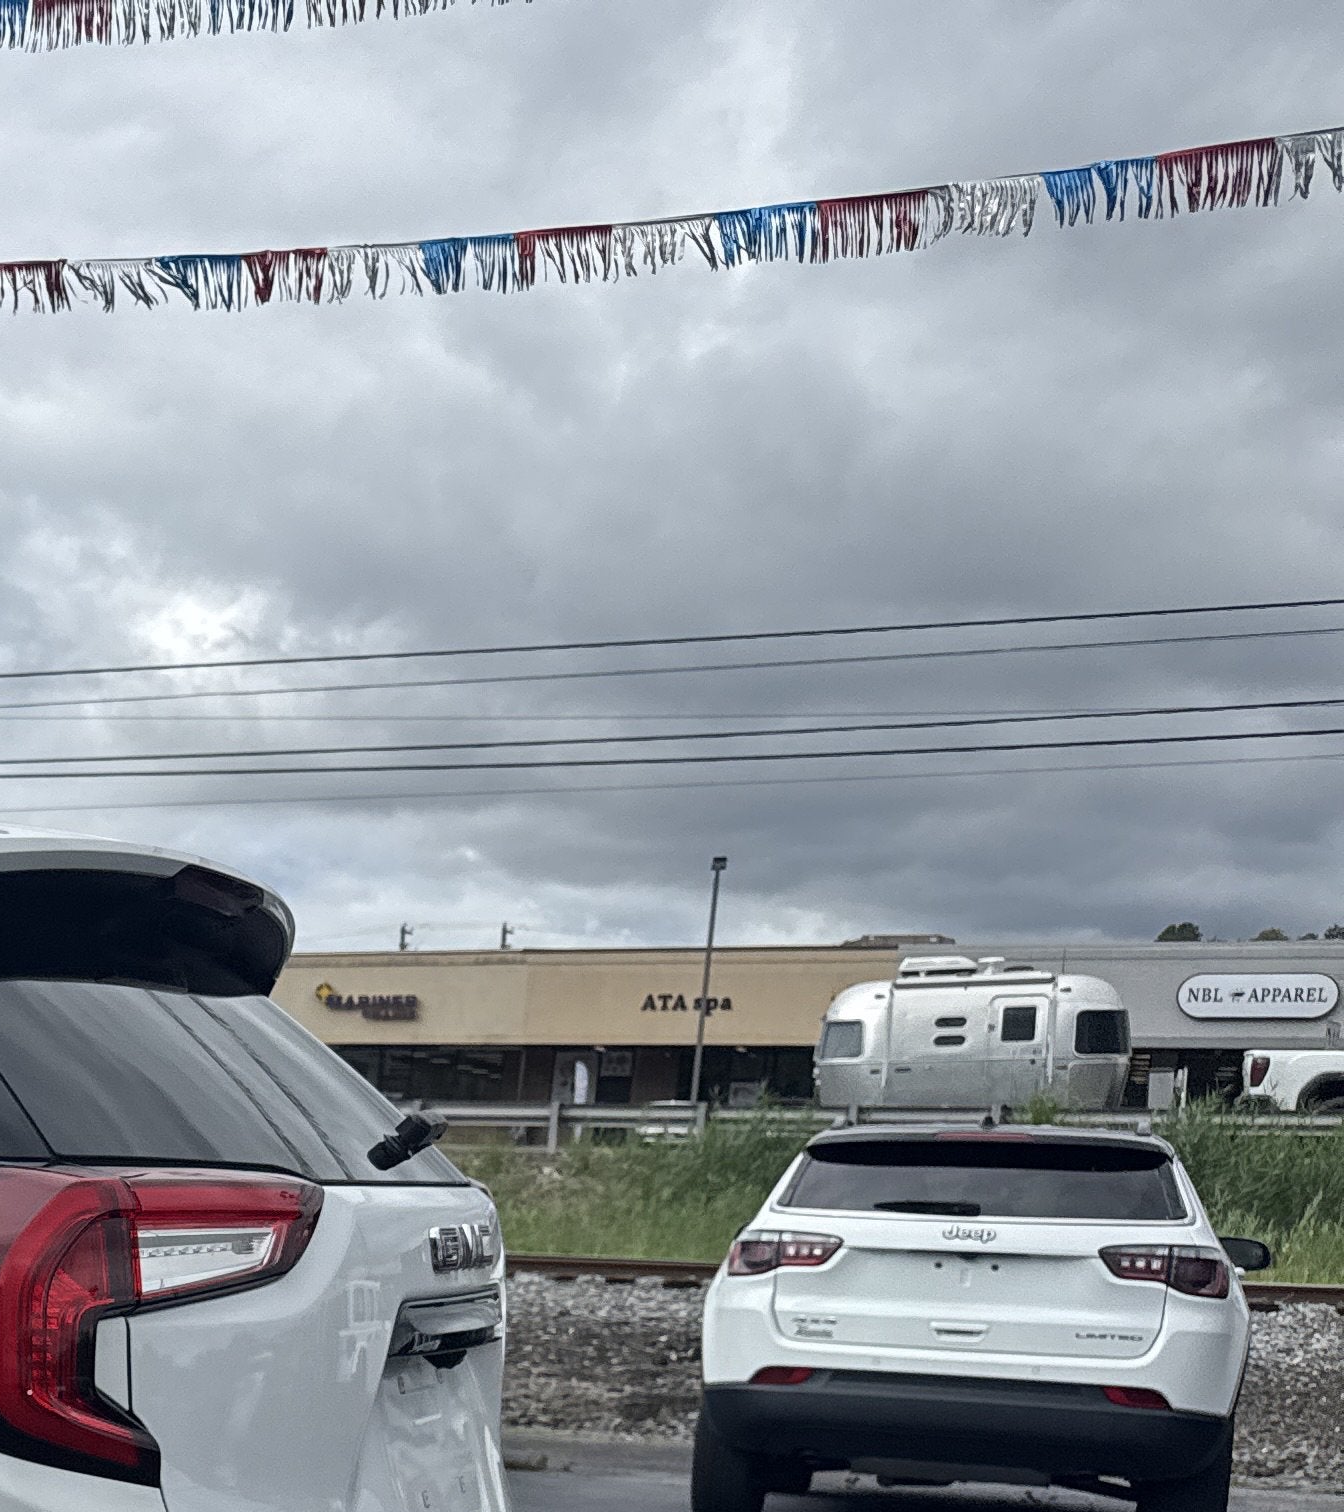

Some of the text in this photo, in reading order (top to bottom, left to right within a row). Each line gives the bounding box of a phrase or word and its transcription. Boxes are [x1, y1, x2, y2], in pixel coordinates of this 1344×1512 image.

[640, 993, 732, 1016] ATA spa
[1186, 987, 1328, 1003] NBL APPAREL
[941, 1224, 997, 1244] Jeep
[428, 1223, 494, 1274] GMC
